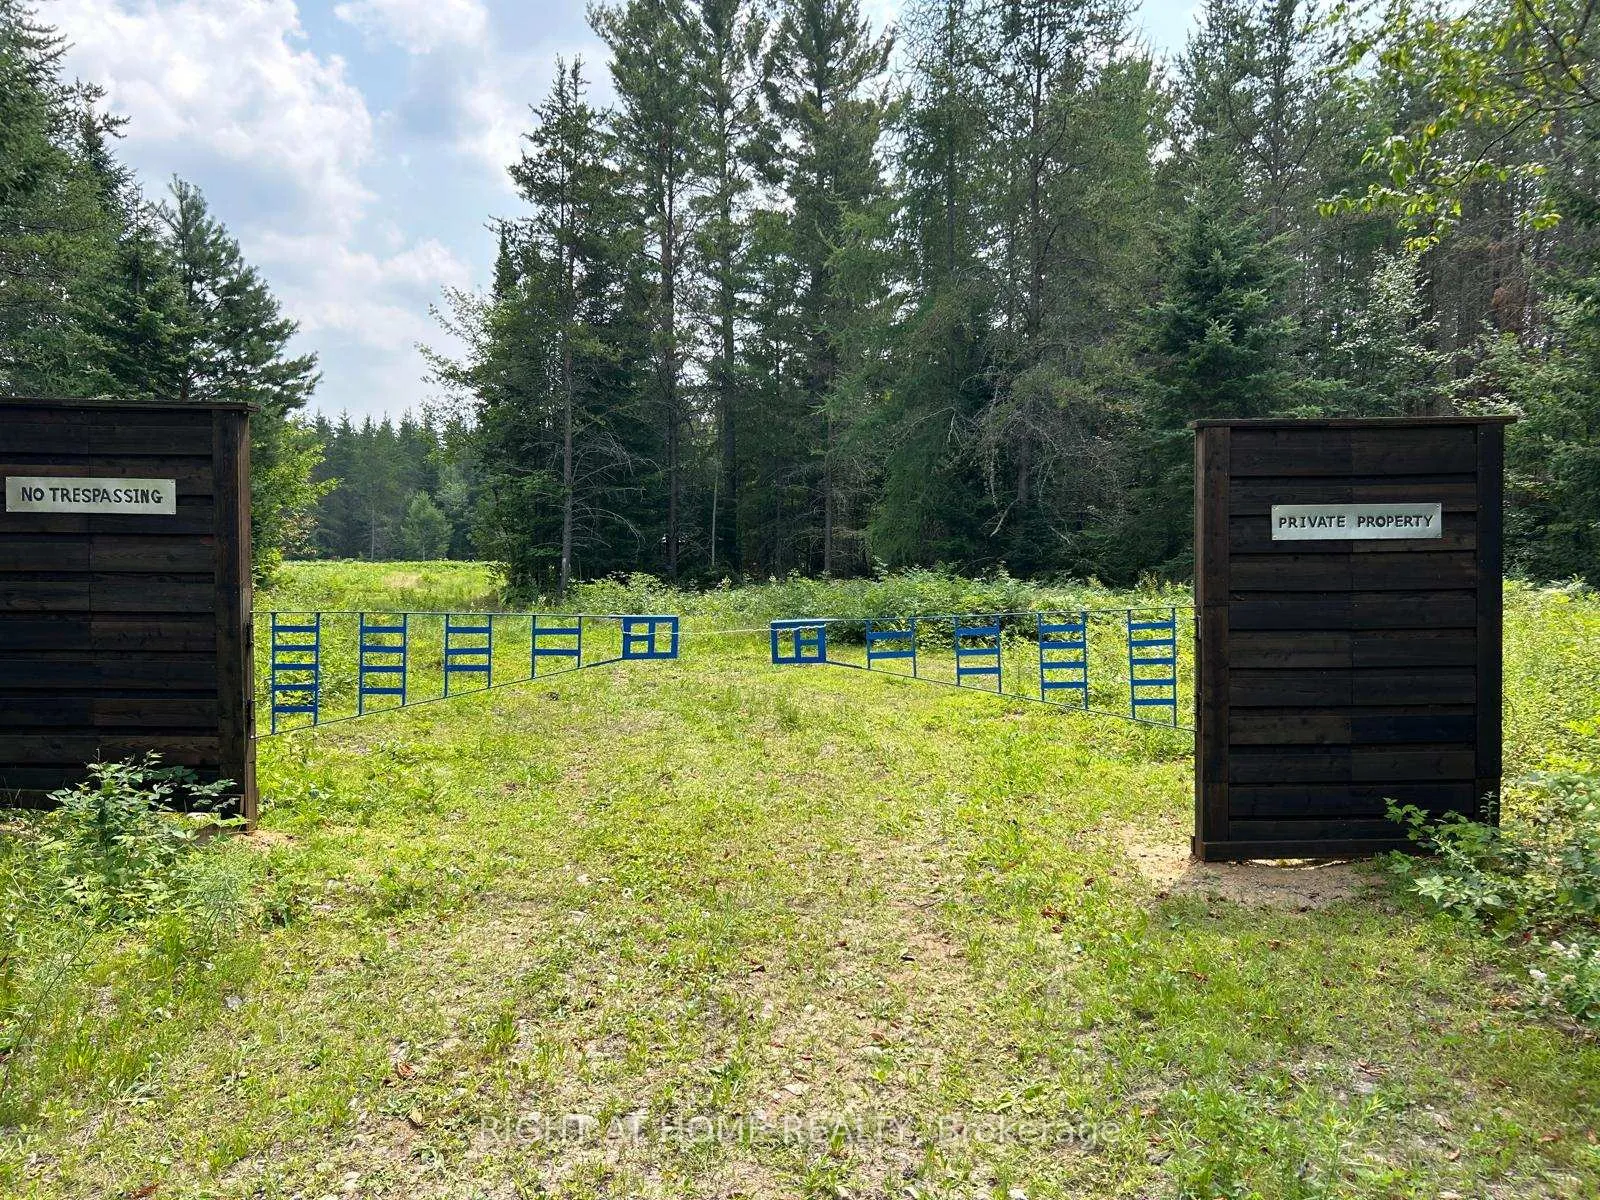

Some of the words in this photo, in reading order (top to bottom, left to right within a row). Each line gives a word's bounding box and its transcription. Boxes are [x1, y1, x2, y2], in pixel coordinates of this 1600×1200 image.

[21, 487, 45, 502] NO
[49, 488, 163, 504] TRESPASSING
[1279, 515, 1346, 528] PRIVATE
[1358, 515, 1434, 528] PROPERTY
